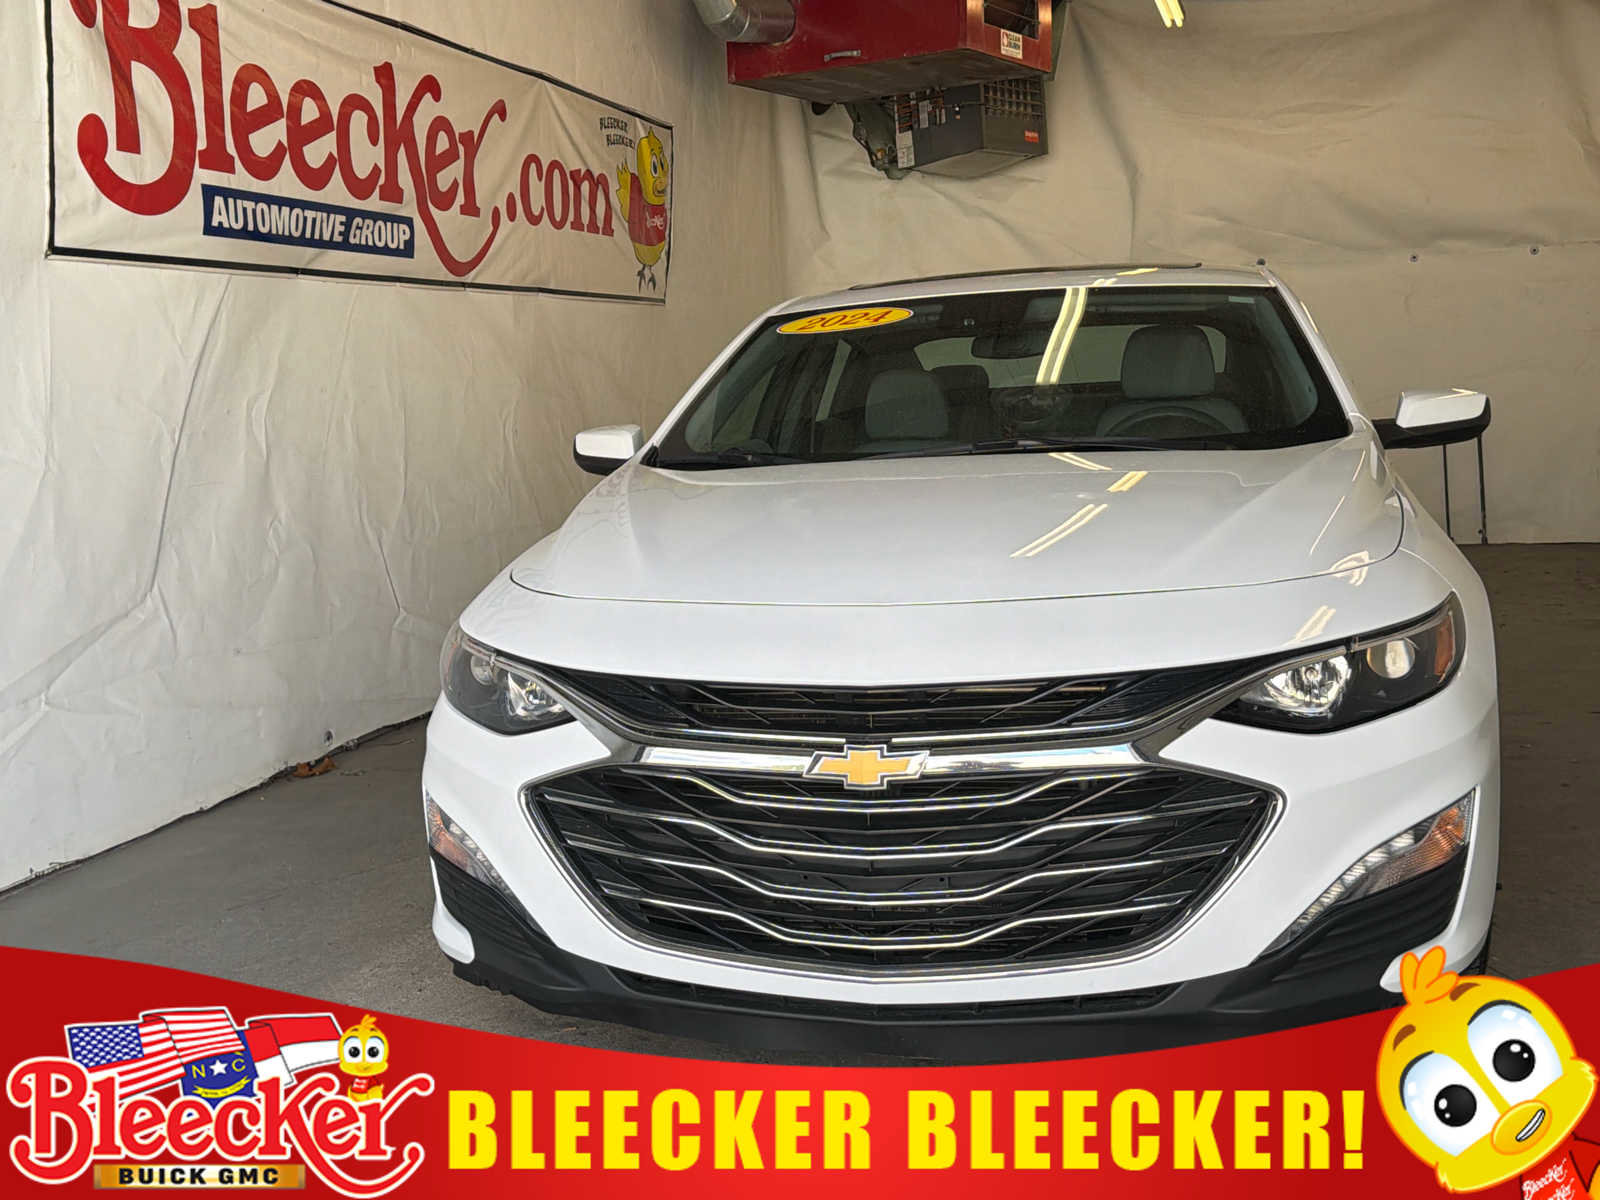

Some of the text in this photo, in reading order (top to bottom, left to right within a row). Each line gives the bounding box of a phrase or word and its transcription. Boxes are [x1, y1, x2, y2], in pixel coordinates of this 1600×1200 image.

[211, 195, 412, 250] AUTOMOTIVE GROUP
[796, 309, 893, 331] 2024
